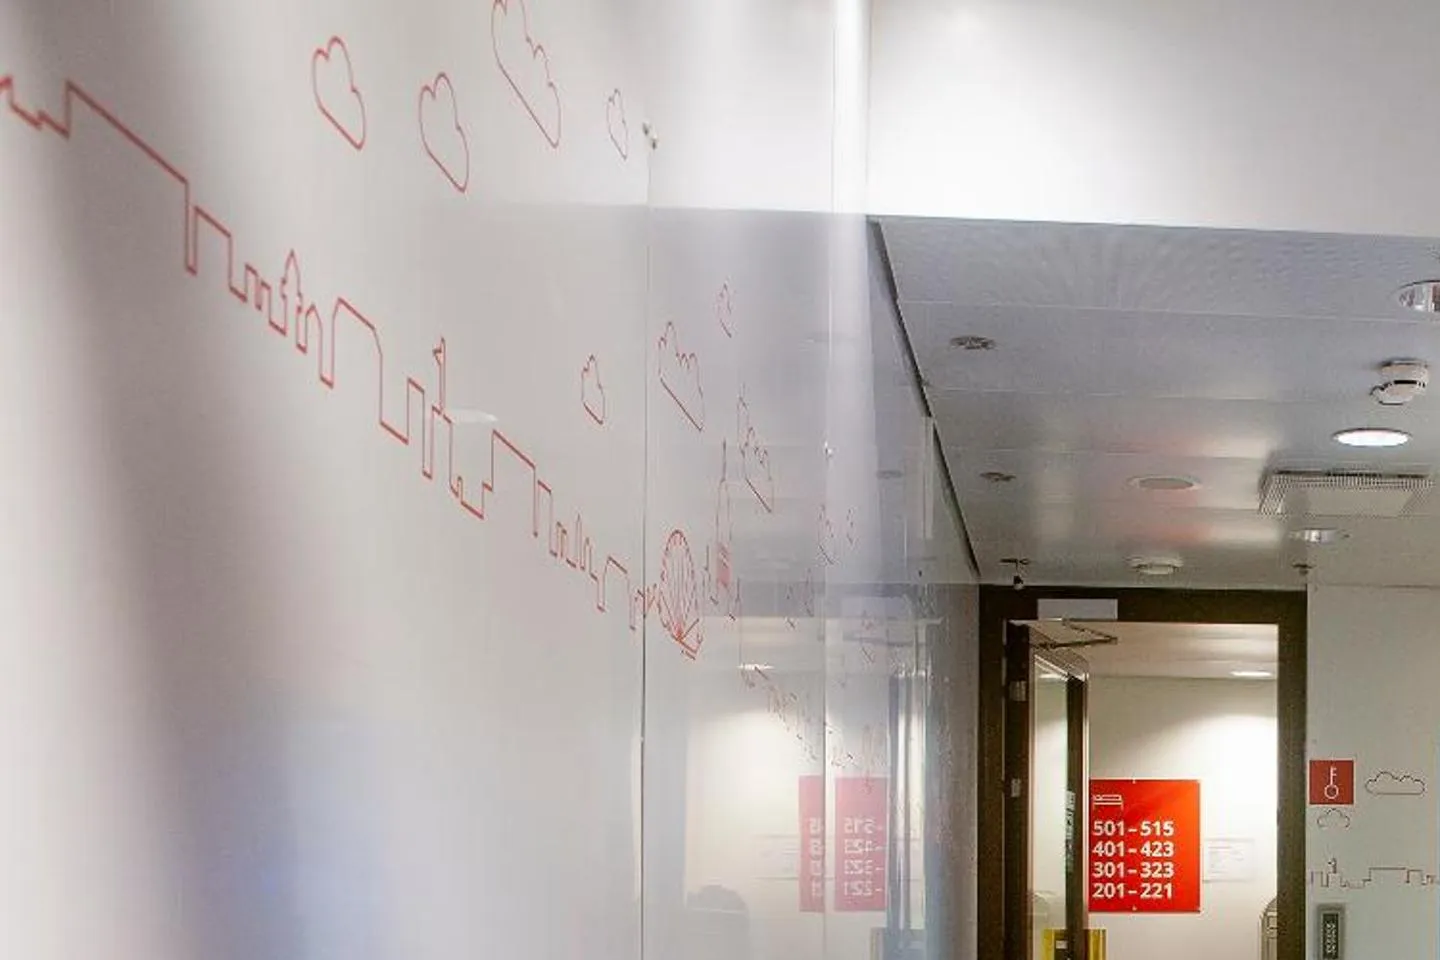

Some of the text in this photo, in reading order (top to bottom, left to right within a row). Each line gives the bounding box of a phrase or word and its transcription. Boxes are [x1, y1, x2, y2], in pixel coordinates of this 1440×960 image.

[1092, 820, 1174, 836] 501-515
[1092, 840, 1174, 857] 401-423
[1092, 861, 1174, 878] 301-323
[1092, 882, 1173, 899] 201-221
